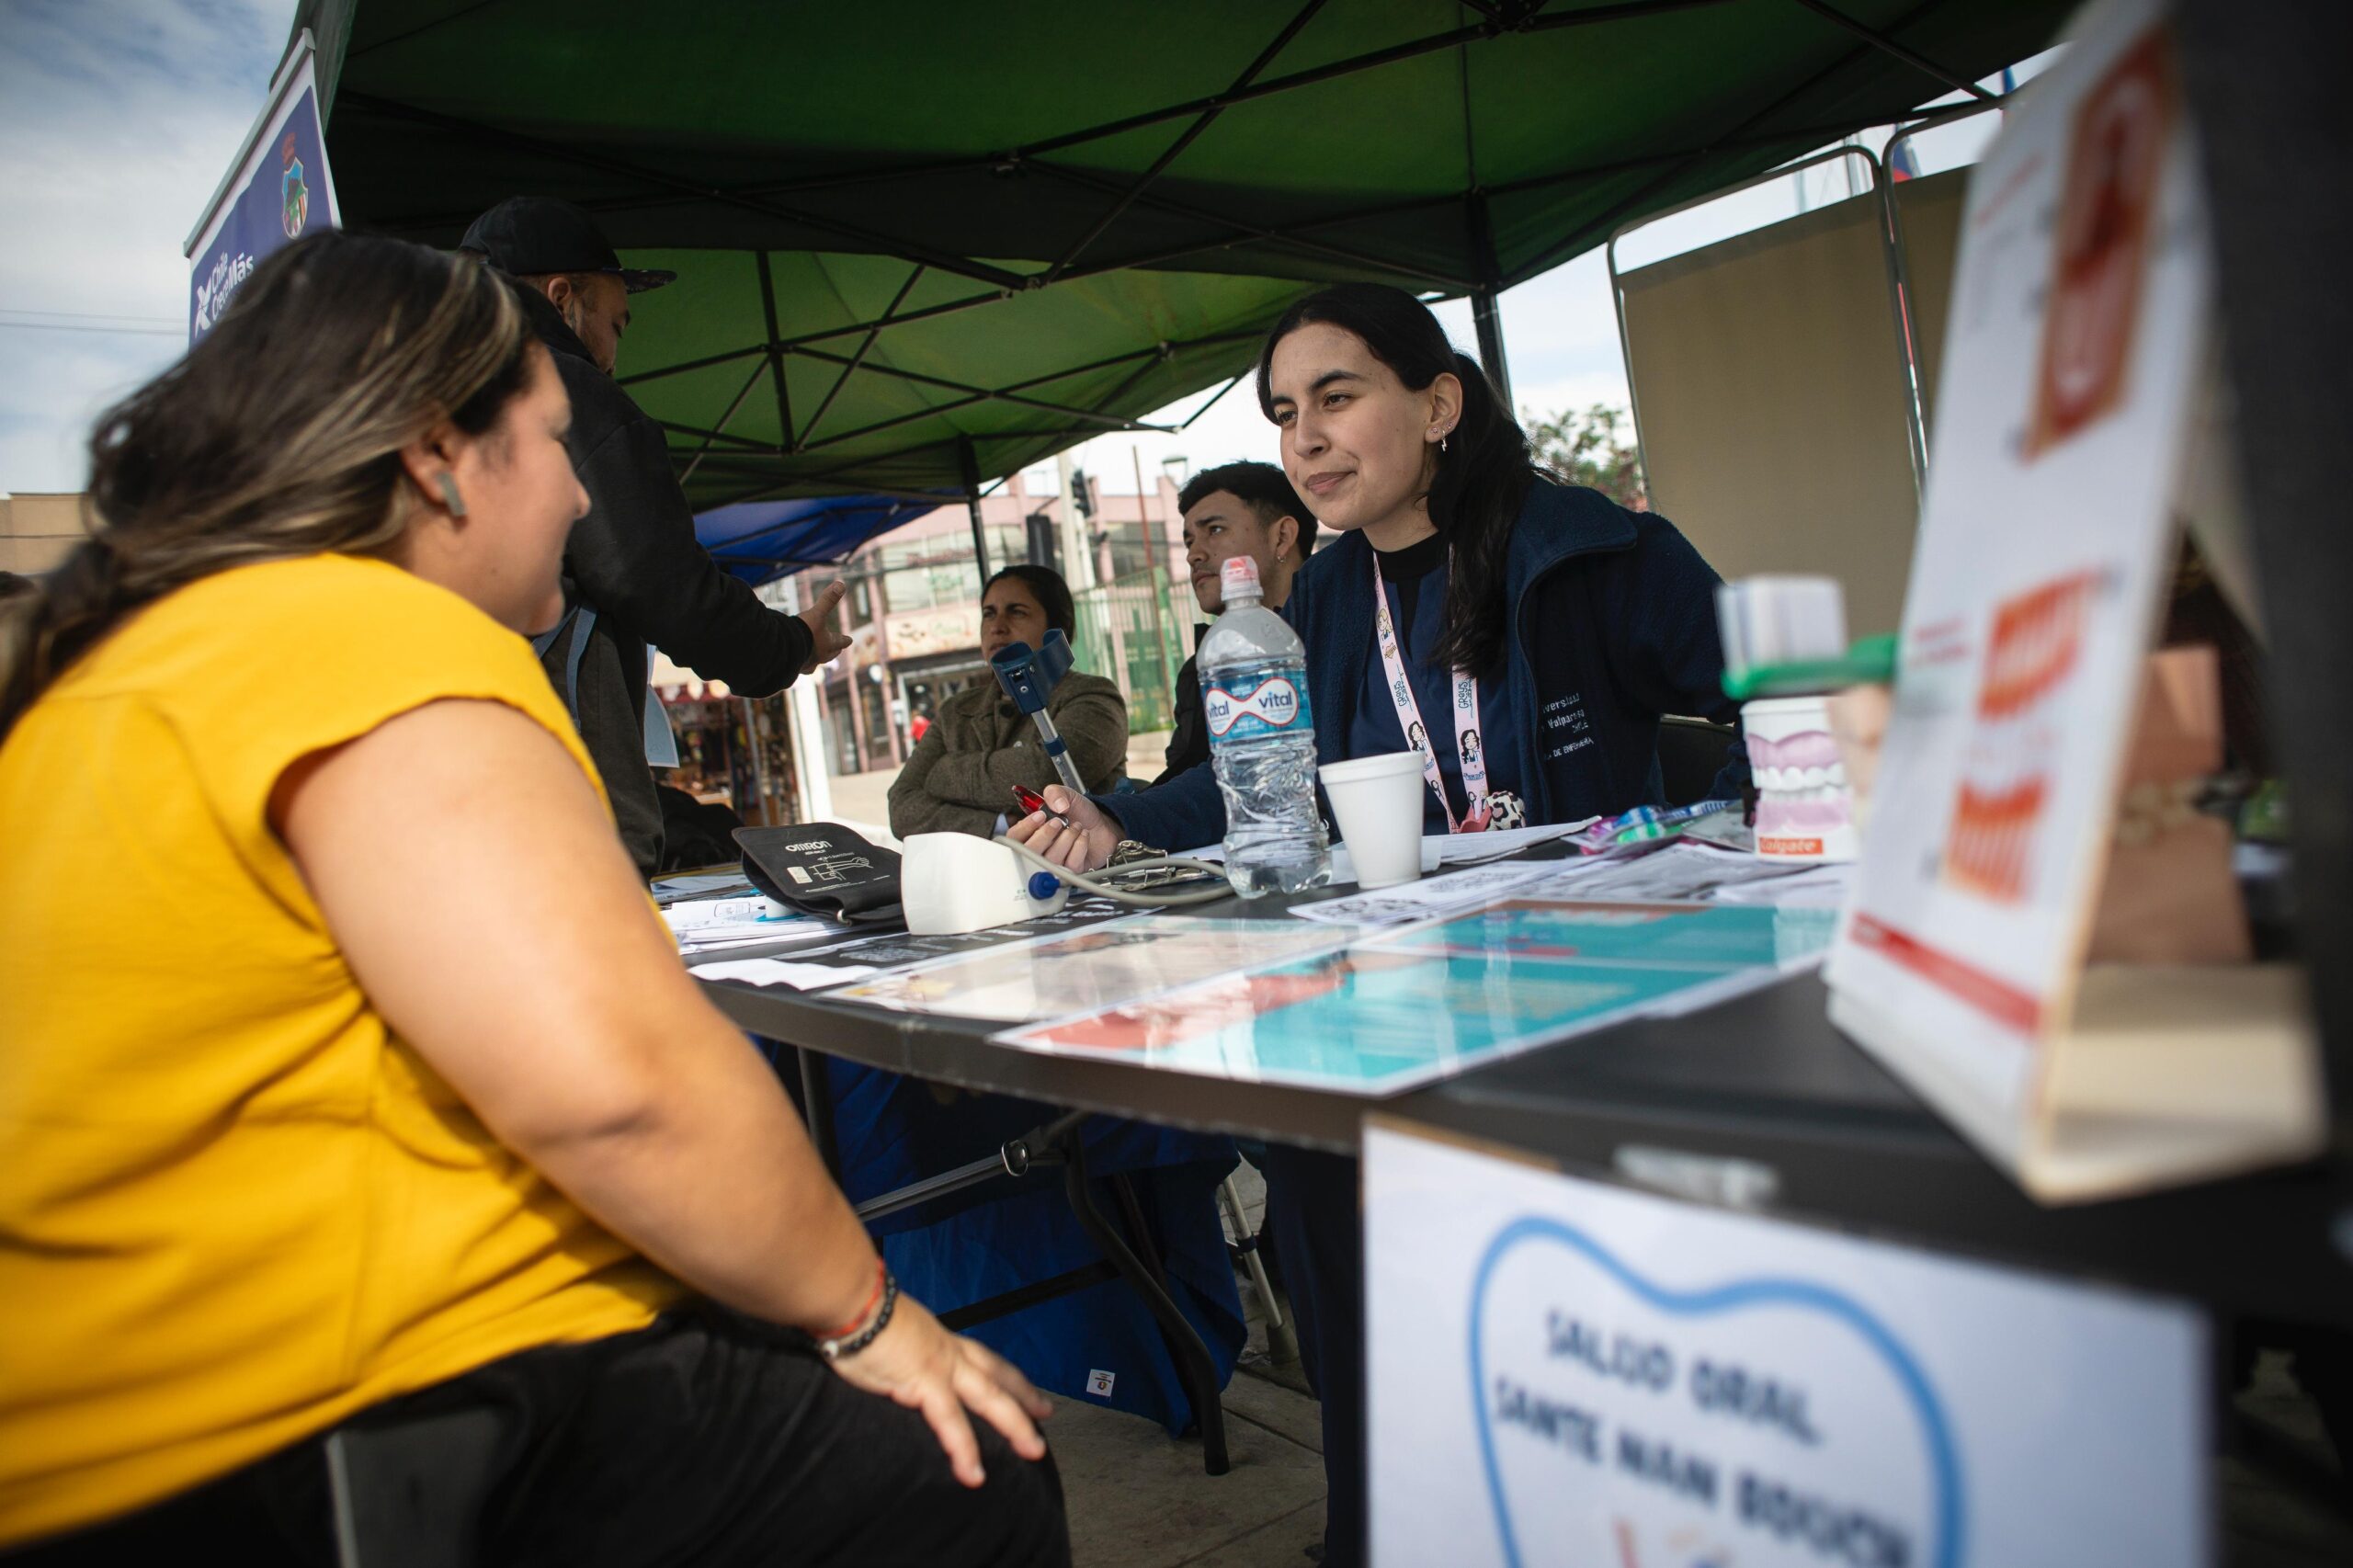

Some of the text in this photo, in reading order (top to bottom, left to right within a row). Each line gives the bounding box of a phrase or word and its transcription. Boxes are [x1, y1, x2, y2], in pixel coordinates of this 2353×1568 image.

[212, 251, 228, 294] Chile
[229, 252, 254, 292] Más
[1259, 691, 1292, 708] vital
[785, 841, 833, 852] OMRON
[1759, 837, 1816, 854] Colgate
[1495, 1376, 1601, 1463] SANTE
[1691, 1358, 1822, 1446] ORAL
